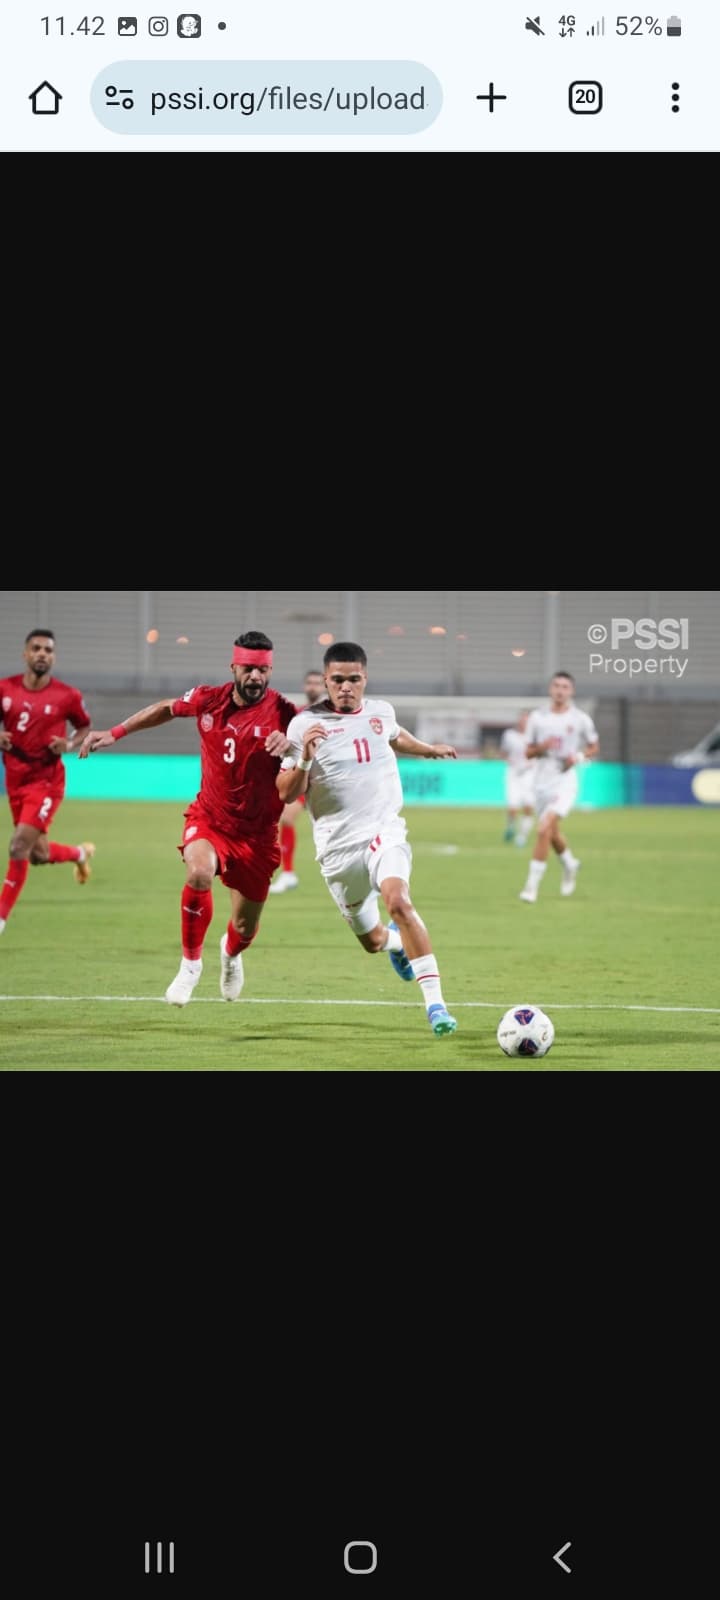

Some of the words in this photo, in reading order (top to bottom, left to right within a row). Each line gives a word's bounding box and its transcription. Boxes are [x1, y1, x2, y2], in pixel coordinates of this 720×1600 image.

[40, 16, 105, 35] 11.42
[558, 15, 576, 26] 4G
[615, 16, 662, 36] 52%
[151, 86, 425, 116] pssi.org/files/upload
[575, 89, 596, 103] 20
[17, 712, 29, 732] 2
[223, 738, 236, 764] 3
[353, 738, 371, 763] 11
[39, 797, 53, 818] 2
